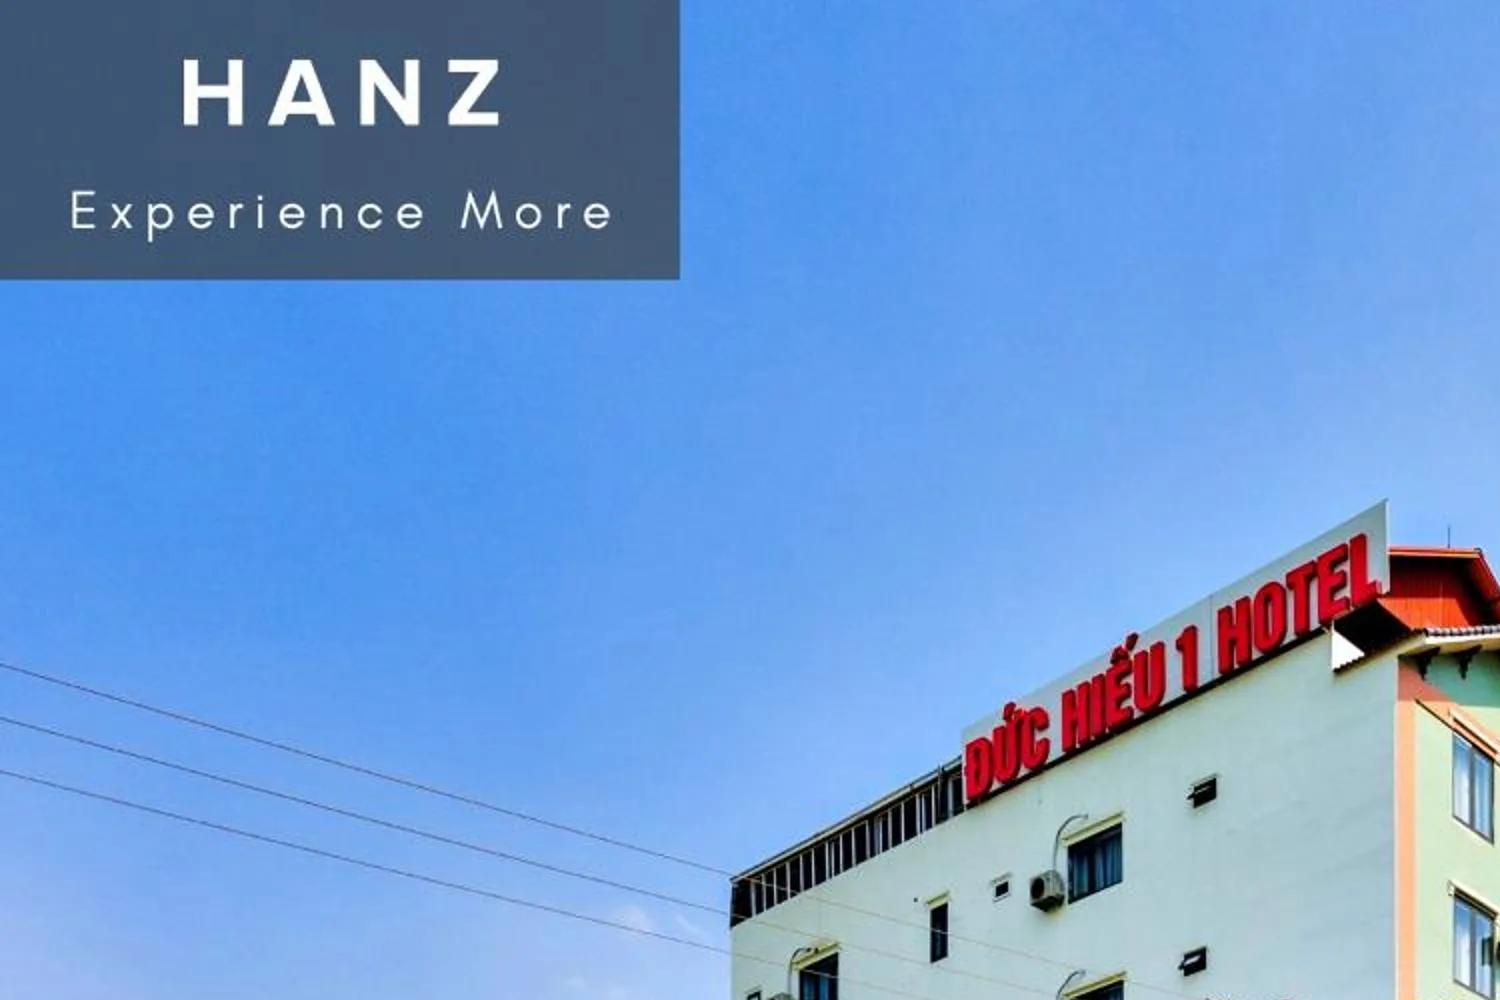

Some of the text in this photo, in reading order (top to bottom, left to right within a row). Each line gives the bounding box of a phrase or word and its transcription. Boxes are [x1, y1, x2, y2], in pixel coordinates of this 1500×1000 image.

[964, 533, 1382, 801] ĐỨC HIẾU 1 HOTEL
